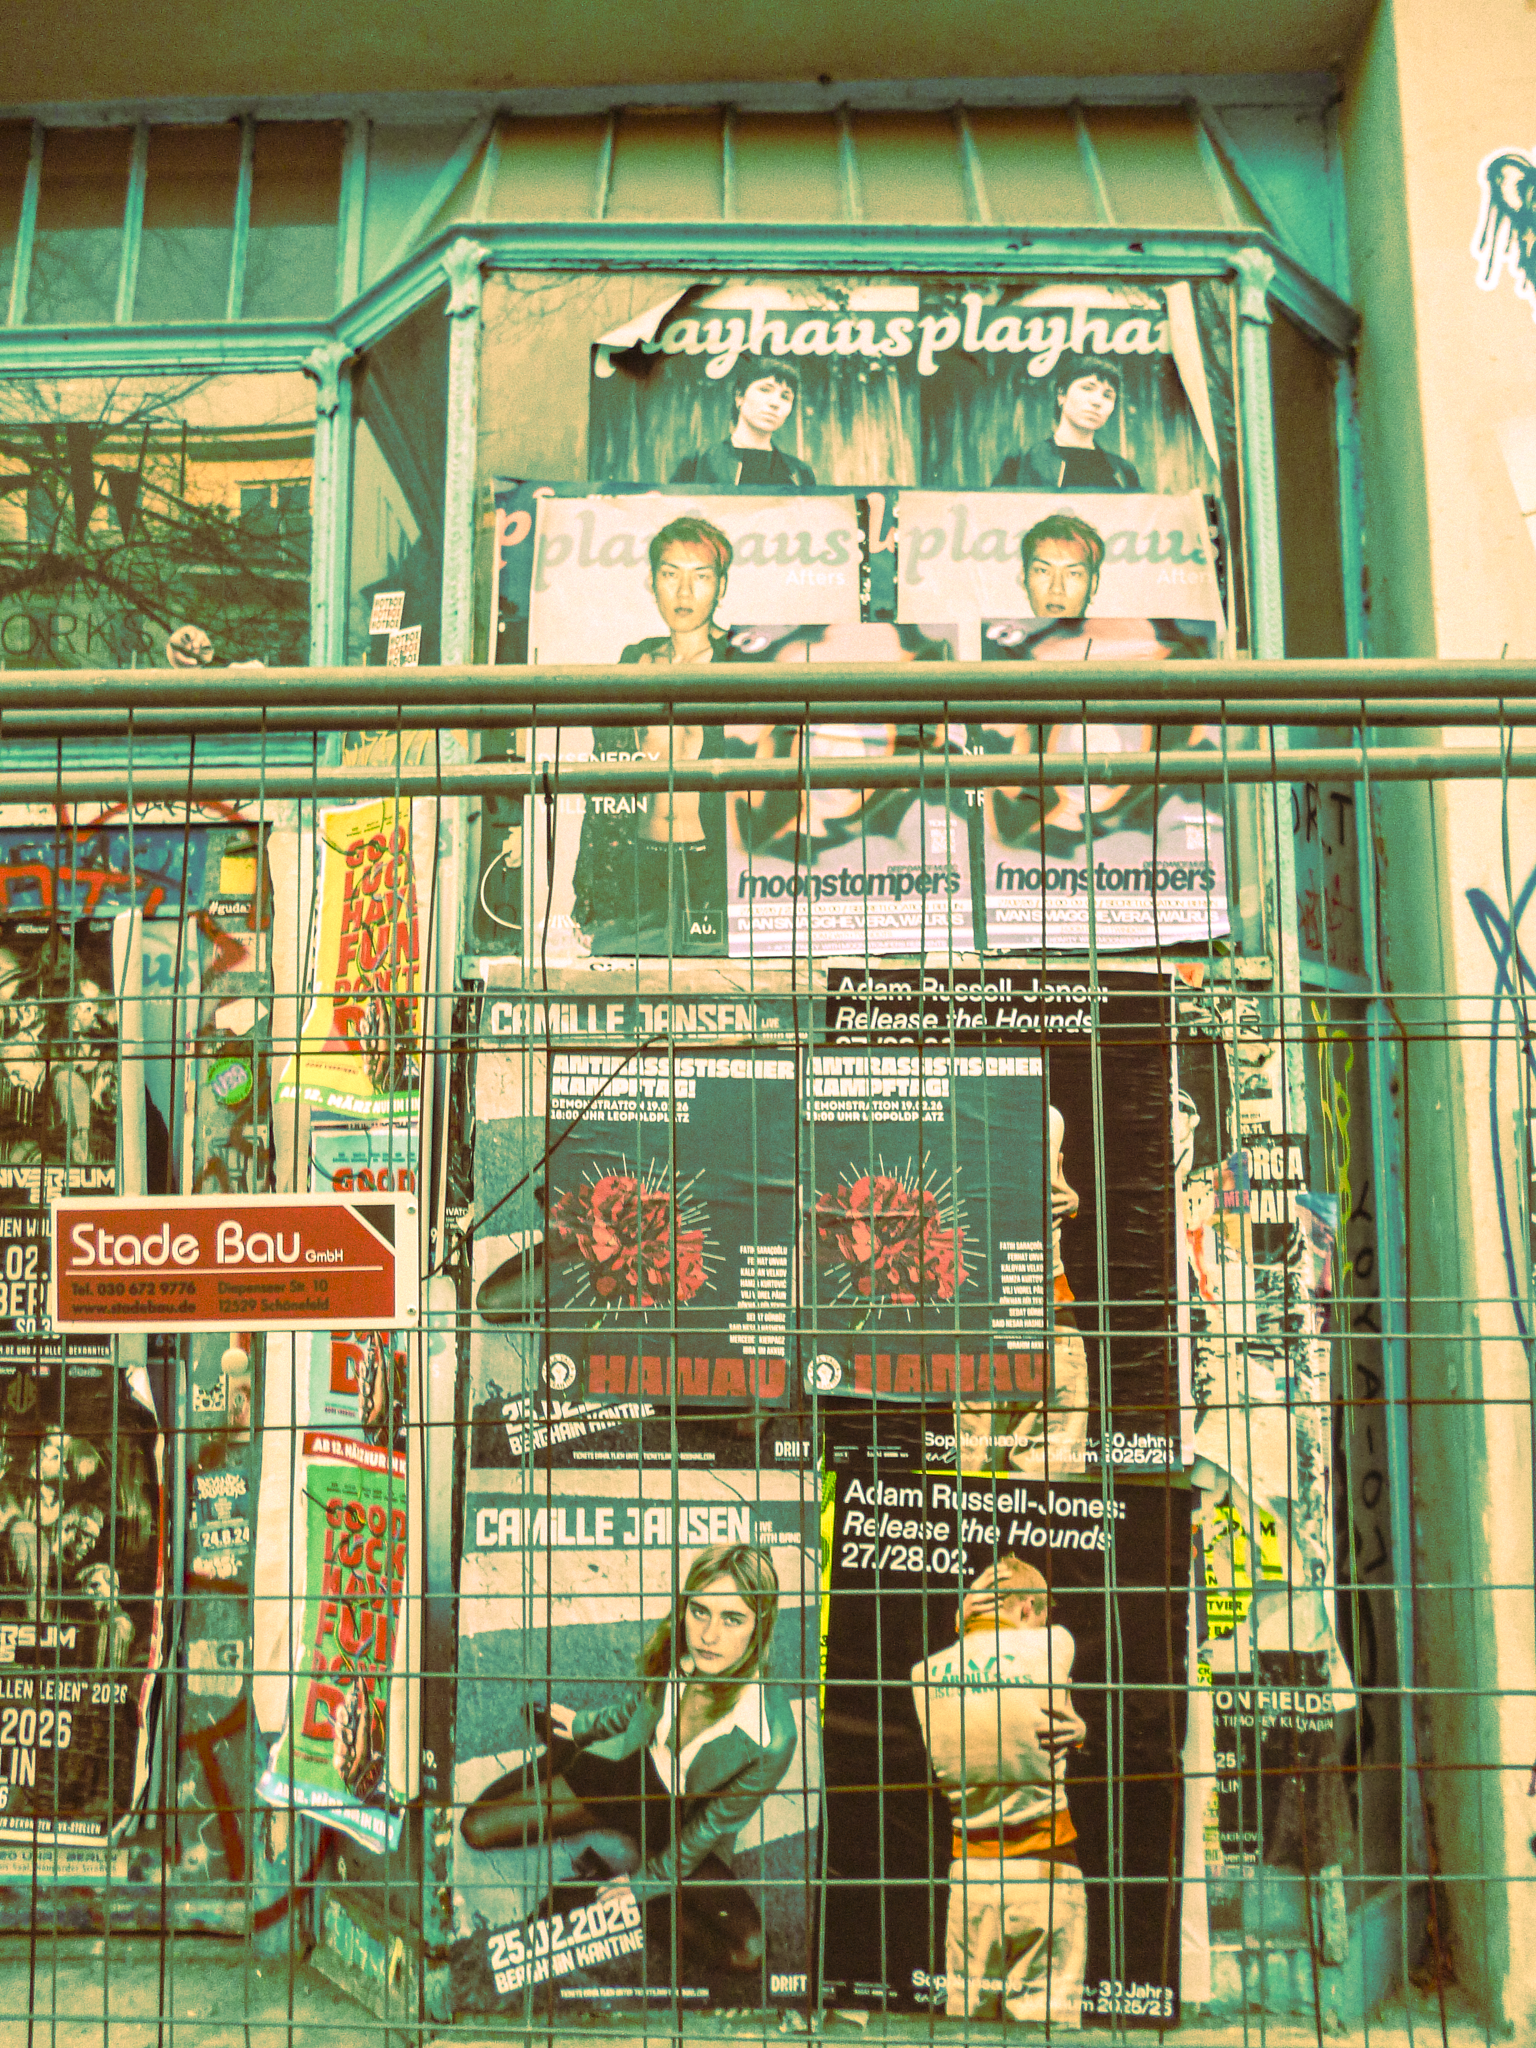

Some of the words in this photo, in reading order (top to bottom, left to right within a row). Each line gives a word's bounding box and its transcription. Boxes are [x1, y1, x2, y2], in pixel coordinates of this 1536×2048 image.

[916, 294, 1172, 378] playha
[534, 508, 852, 593] plaaus
[786, 571, 846, 587] Afters
[738, 867, 961, 904] moonstompers
[995, 861, 1216, 897] moonstompers
[1032, 909, 1111, 923] SMAGGE,
[607, 1111, 690, 1124] LEOPOLDPLTZ
[71, 1222, 200, 1267] Stade
[216, 1219, 301, 1265] Bau
[305, 1248, 345, 1263] GmbH
[71, 1282, 95, 1297] Tel.
[97, 1282, 126, 1297] 030
[128, 1282, 156, 1296] 672
[159, 1280, 197, 1296] 9776
[312, 1279, 329, 1293] 10
[71, 1301, 197, 1315] www.stadebau.de
[218, 1299, 257, 1313] 12529
[260, 1297, 330, 1313] Schönefeld
[588, 1354, 787, 1399] HANAU
[843, 1478, 924, 1508] Adam
[932, 1483, 1127, 1520] Russell-Jones:
[842, 1510, 950, 1542] Release
[960, 1517, 1000, 1545] the
[1007, 1520, 1112, 1551] Hounds
[840, 1542, 975, 1576] 27./28.02.
[576, 1927, 644, 1968] KANTINE
[770, 1974, 808, 1992] DRIFT
